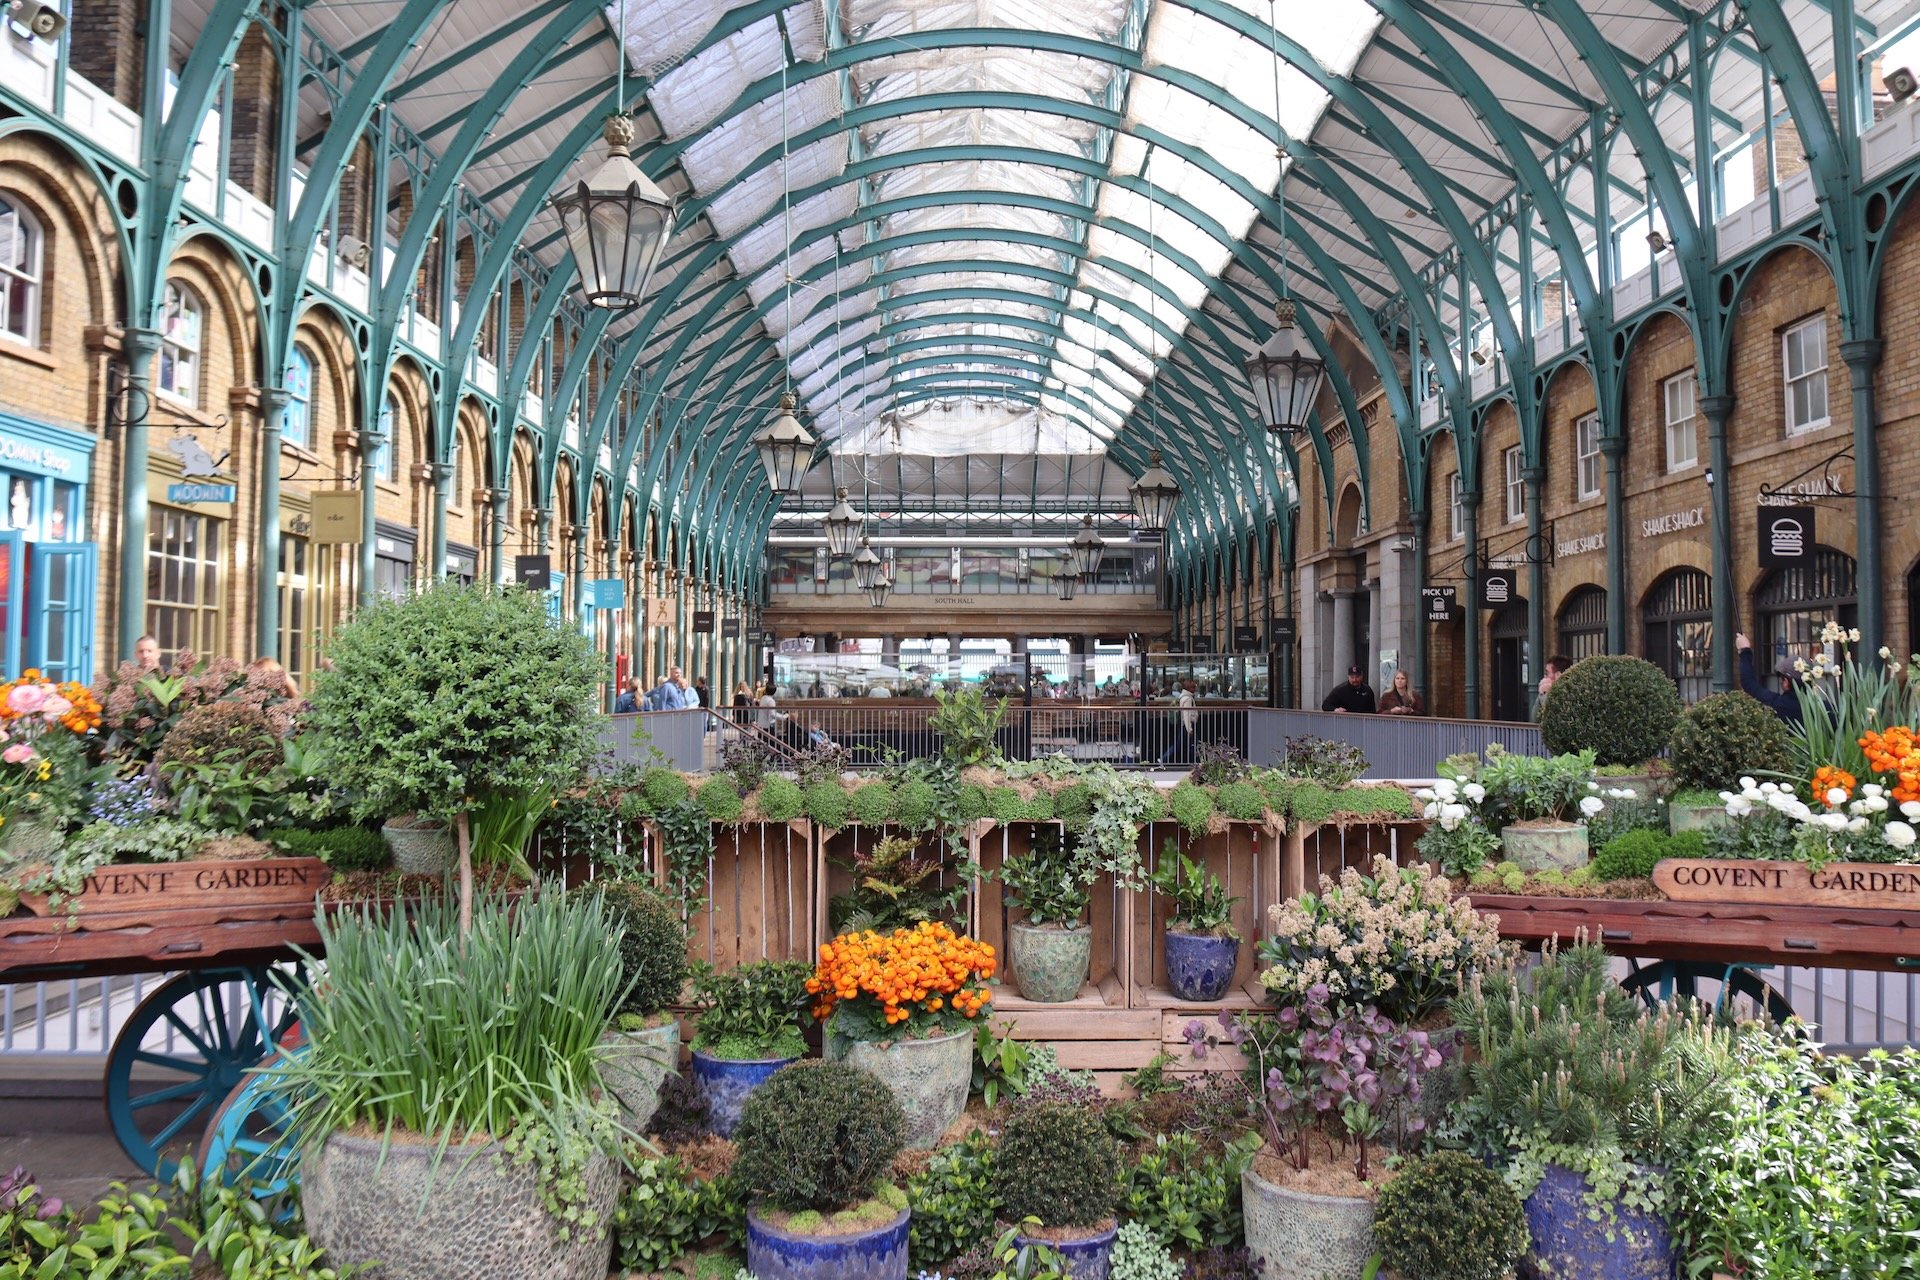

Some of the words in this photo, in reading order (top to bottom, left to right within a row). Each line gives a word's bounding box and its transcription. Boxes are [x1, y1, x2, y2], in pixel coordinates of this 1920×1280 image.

[173, 485, 225, 500] MOOMIN
[1642, 515, 1672, 538] SHAKE
[1672, 507, 1704, 531] SHACK
[1556, 538, 1580, 558] SHAKE
[1580, 532, 1605, 553] SHACK
[934, 597, 957, 605] SOUTH
[957, 597, 976, 605] HALL
[1422, 588, 1441, 596] PICK
[1443, 588, 1455, 596] UP
[1429, 612, 1450, 620] HERE
[69, 871, 174, 897] OVENT
[195, 866, 310, 891] GARDEN
[1673, 866, 1788, 889] COVENT
[1809, 870, 1920, 894] GARDEN
